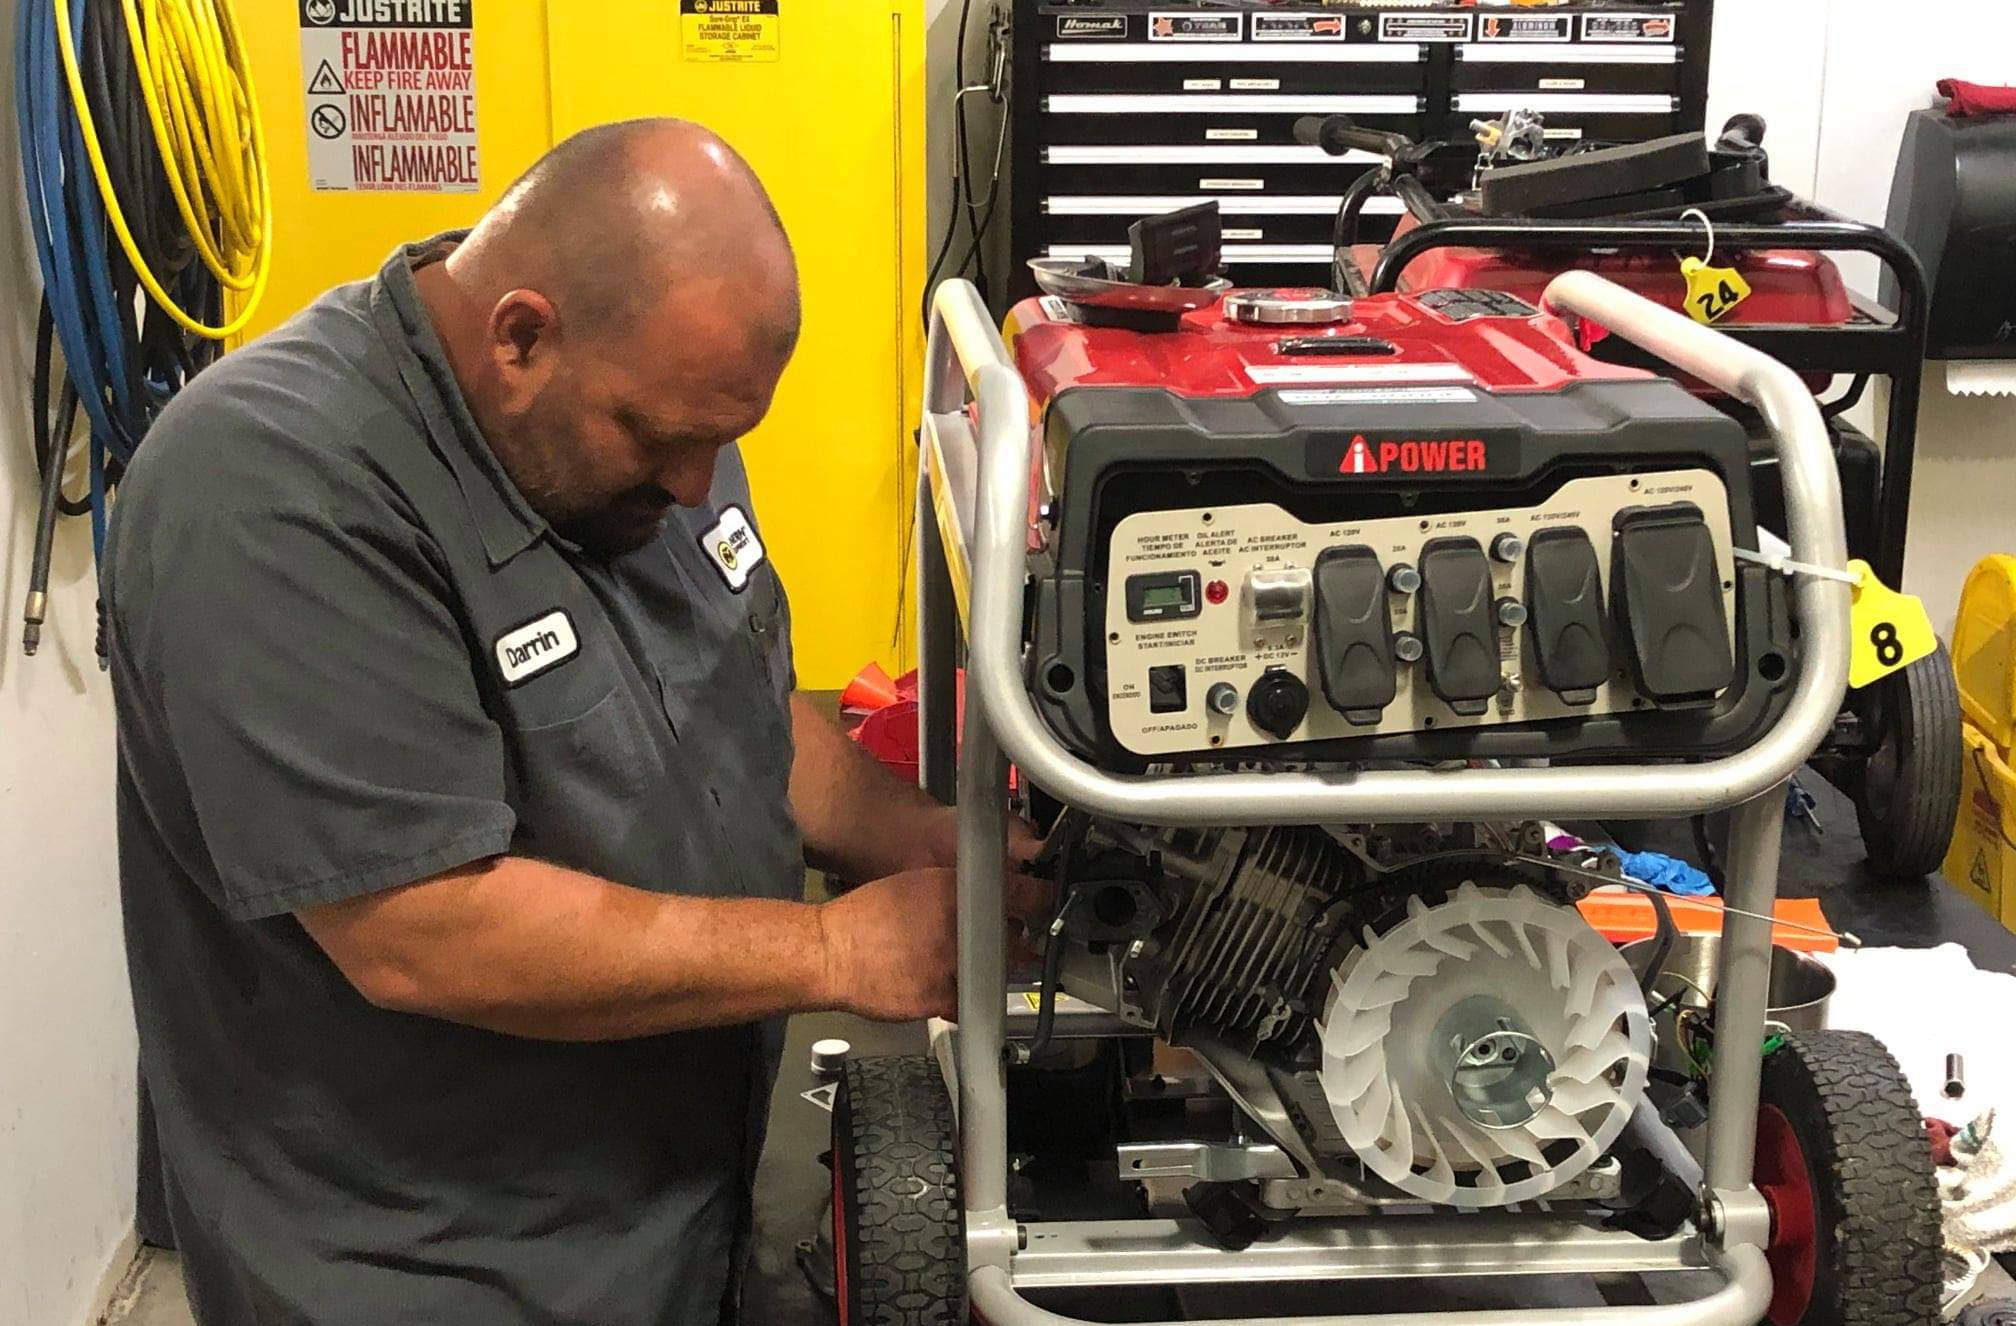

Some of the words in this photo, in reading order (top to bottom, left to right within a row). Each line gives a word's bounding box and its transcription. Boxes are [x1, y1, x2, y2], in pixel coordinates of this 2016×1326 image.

[340, 0, 461, 22] JUSTRITE
[709, 0, 760, 11] JUSTRITE
[698, 24, 738, 32] FLAMMABLE
[1064, 19, 1123, 29] Homak
[699, 32, 731, 40] STORAGE
[732, 32, 760, 40] CABINET
[341, 32, 472, 70] FLAMMABLE
[344, 71, 383, 90] KEEP
[388, 71, 421, 90] FIRE
[426, 72, 472, 91] AWAY
[350, 94, 475, 133] INFLAMABLE
[352, 145, 478, 183] INFLAMMABLE
[1696, 280, 1739, 320] 24
[1137, 535, 1160, 543] HOUR
[1162, 533, 1189, 542] METER
[1211, 530, 1235, 538] ALERT
[1330, 529, 1341, 537] AC
[1343, 528, 1360, 536] 120V
[1195, 539, 1225, 548] ALERTA
[1248, 536, 1259, 544] AC
[1260, 533, 1297, 543] BREAKER
[1141, 543, 1171, 551] TIEMPO
[1203, 547, 1230, 555] ACEITE
[1239, 545, 1250, 553] AC
[1250, 542, 1306, 552] INTERRUPTOR
[1125, 550, 1197, 561] FUNCIONAMIENTO
[1136, 632, 1164, 641] ENGINE
[1167, 630, 1197, 638] SWITCH
[506, 629, 560, 668] Darrin
[1138, 639, 1195, 649] START/INICIAR
[1870, 622, 1903, 667] 8
[1207, 655, 1246, 664] BREAKER
[1123, 683, 1135, 691] ON
[1141, 723, 1198, 734] OFF/APAGADO
